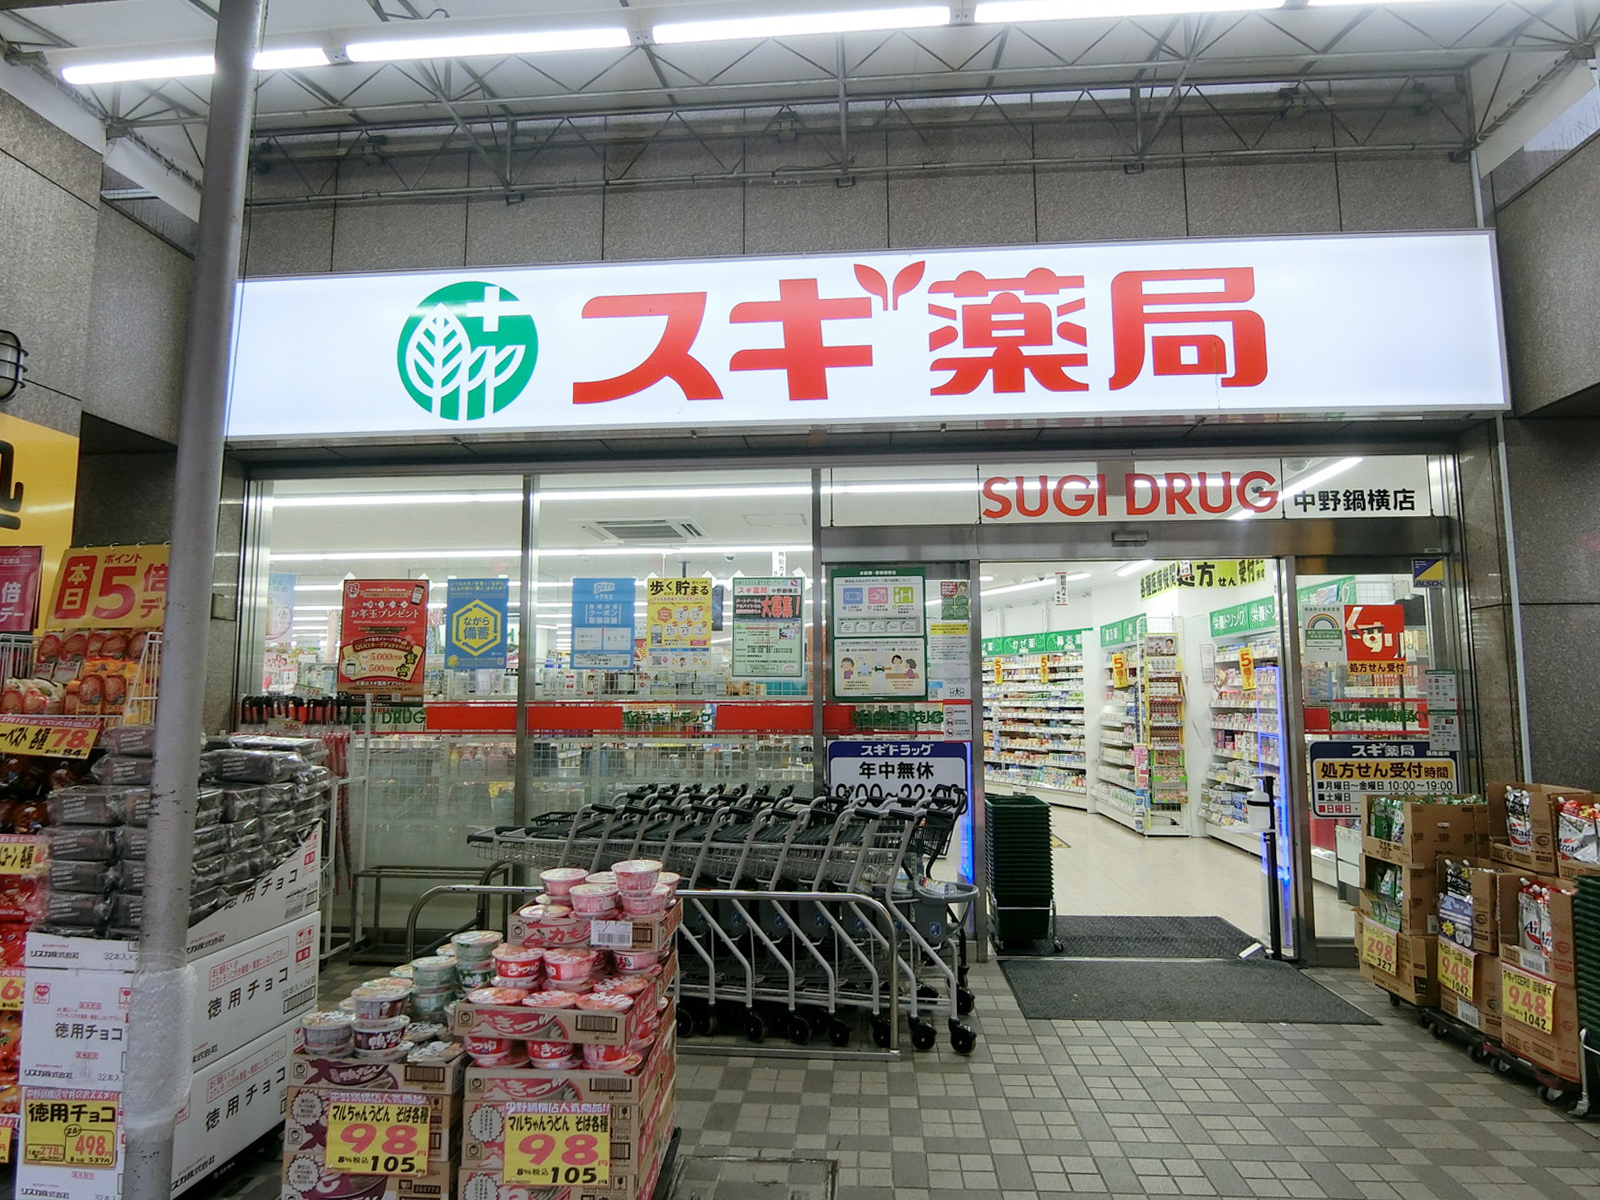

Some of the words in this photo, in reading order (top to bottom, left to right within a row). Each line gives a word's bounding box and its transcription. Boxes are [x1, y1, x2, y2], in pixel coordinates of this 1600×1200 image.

[572, 260, 1269, 404] スギ薬局
[982, 474, 1106, 518] SUGI
[1124, 471, 1277, 516] DRUG
[1293, 488, 1416, 513] 中野鍋横店
[104, 552, 143, 564] ポイント
[2, 582, 21, 603] 倍
[67, 563, 91, 609] 本日
[350, 609, 420, 618] お年玉プレゼント
[463, 617, 490, 626] ながら
[1349, 663, 1405, 673] 処方せん受付
[29, 728, 52, 750] 各種
[860, 743, 934, 756] スギドラッグ
[1352, 742, 1416, 757] スギ薬局
[859, 761, 934, 780] 年中無休
[1326, 793, 1351, 801] 土曜日
[207, 966, 288, 1020] 徳用チョコ
[1508, 985, 1548, 1018] 948
[55, 1022, 124, 1042] 徳用チョコ
[205, 1066, 287, 1133] 徳用チョコ
[29, 1103, 116, 1122] 徳用チョコ
[332, 1105, 391, 1123] マルちゃんうどん
[396, 1106, 428, 1124] そば各種
[508, 1115, 570, 1132] マルちゃんうどん
[575, 1115, 609, 1133] そば各種
